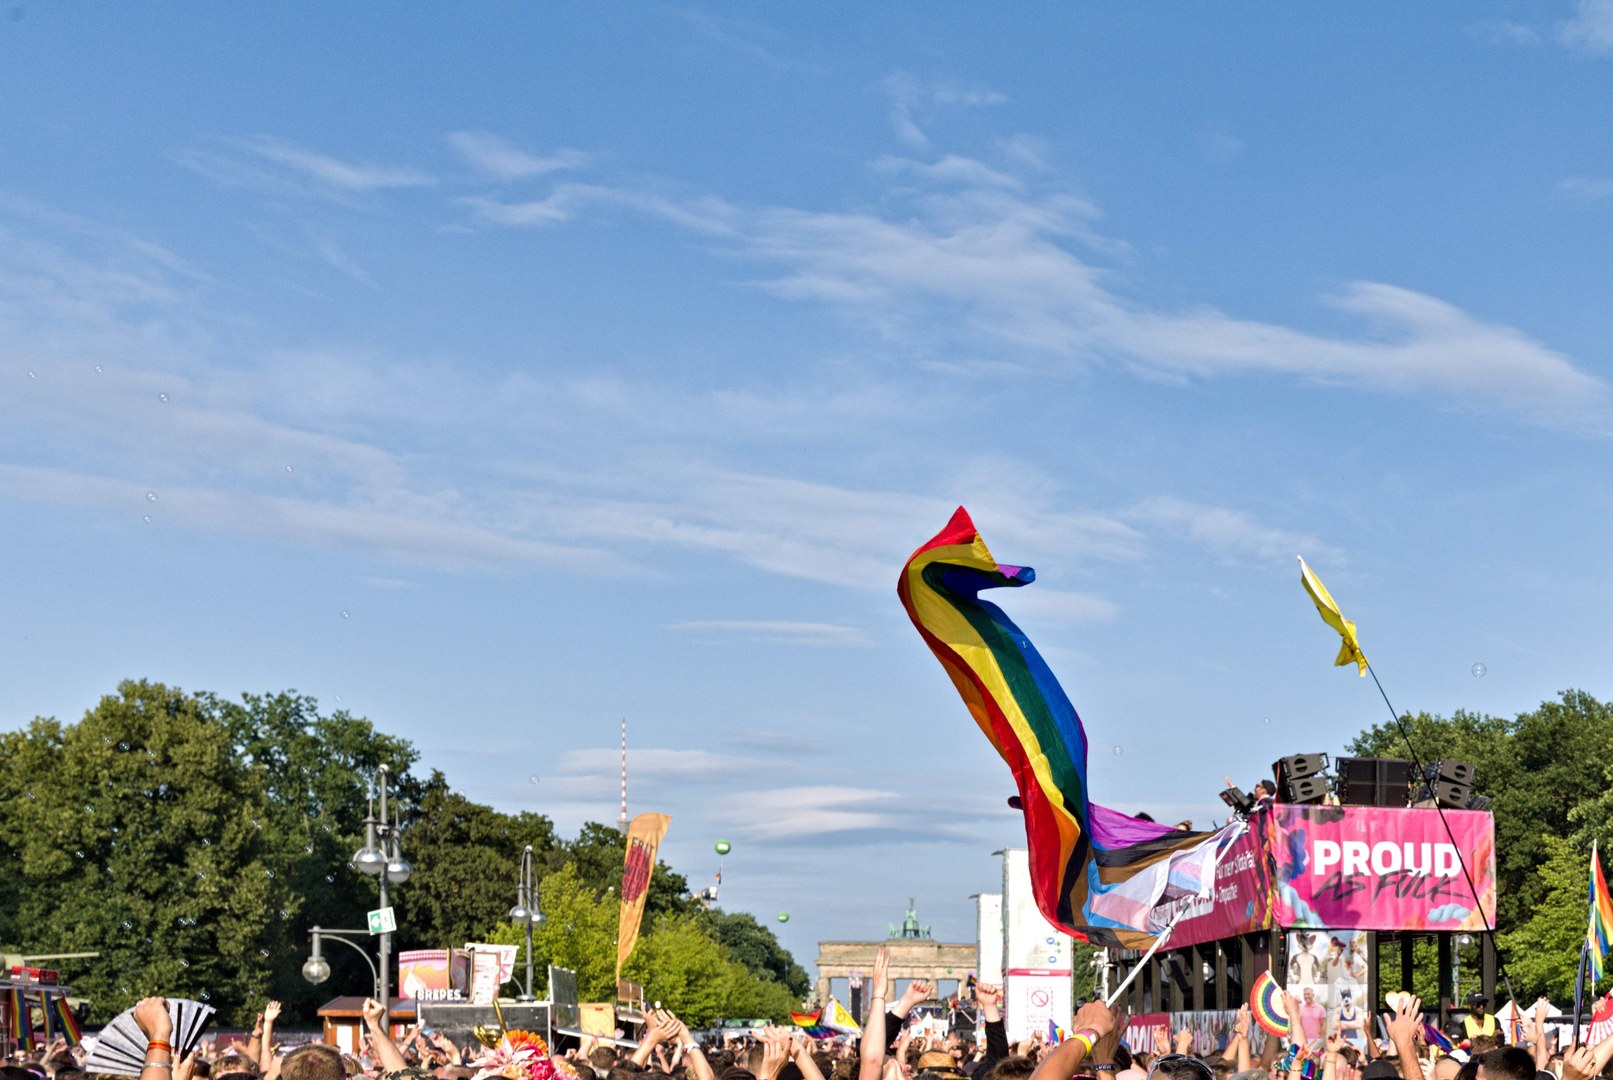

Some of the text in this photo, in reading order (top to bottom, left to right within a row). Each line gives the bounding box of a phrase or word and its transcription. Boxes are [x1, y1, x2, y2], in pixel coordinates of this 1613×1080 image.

[1313, 839, 1463, 878] PROUD
[1312, 868, 1471, 907] AS FUCK
